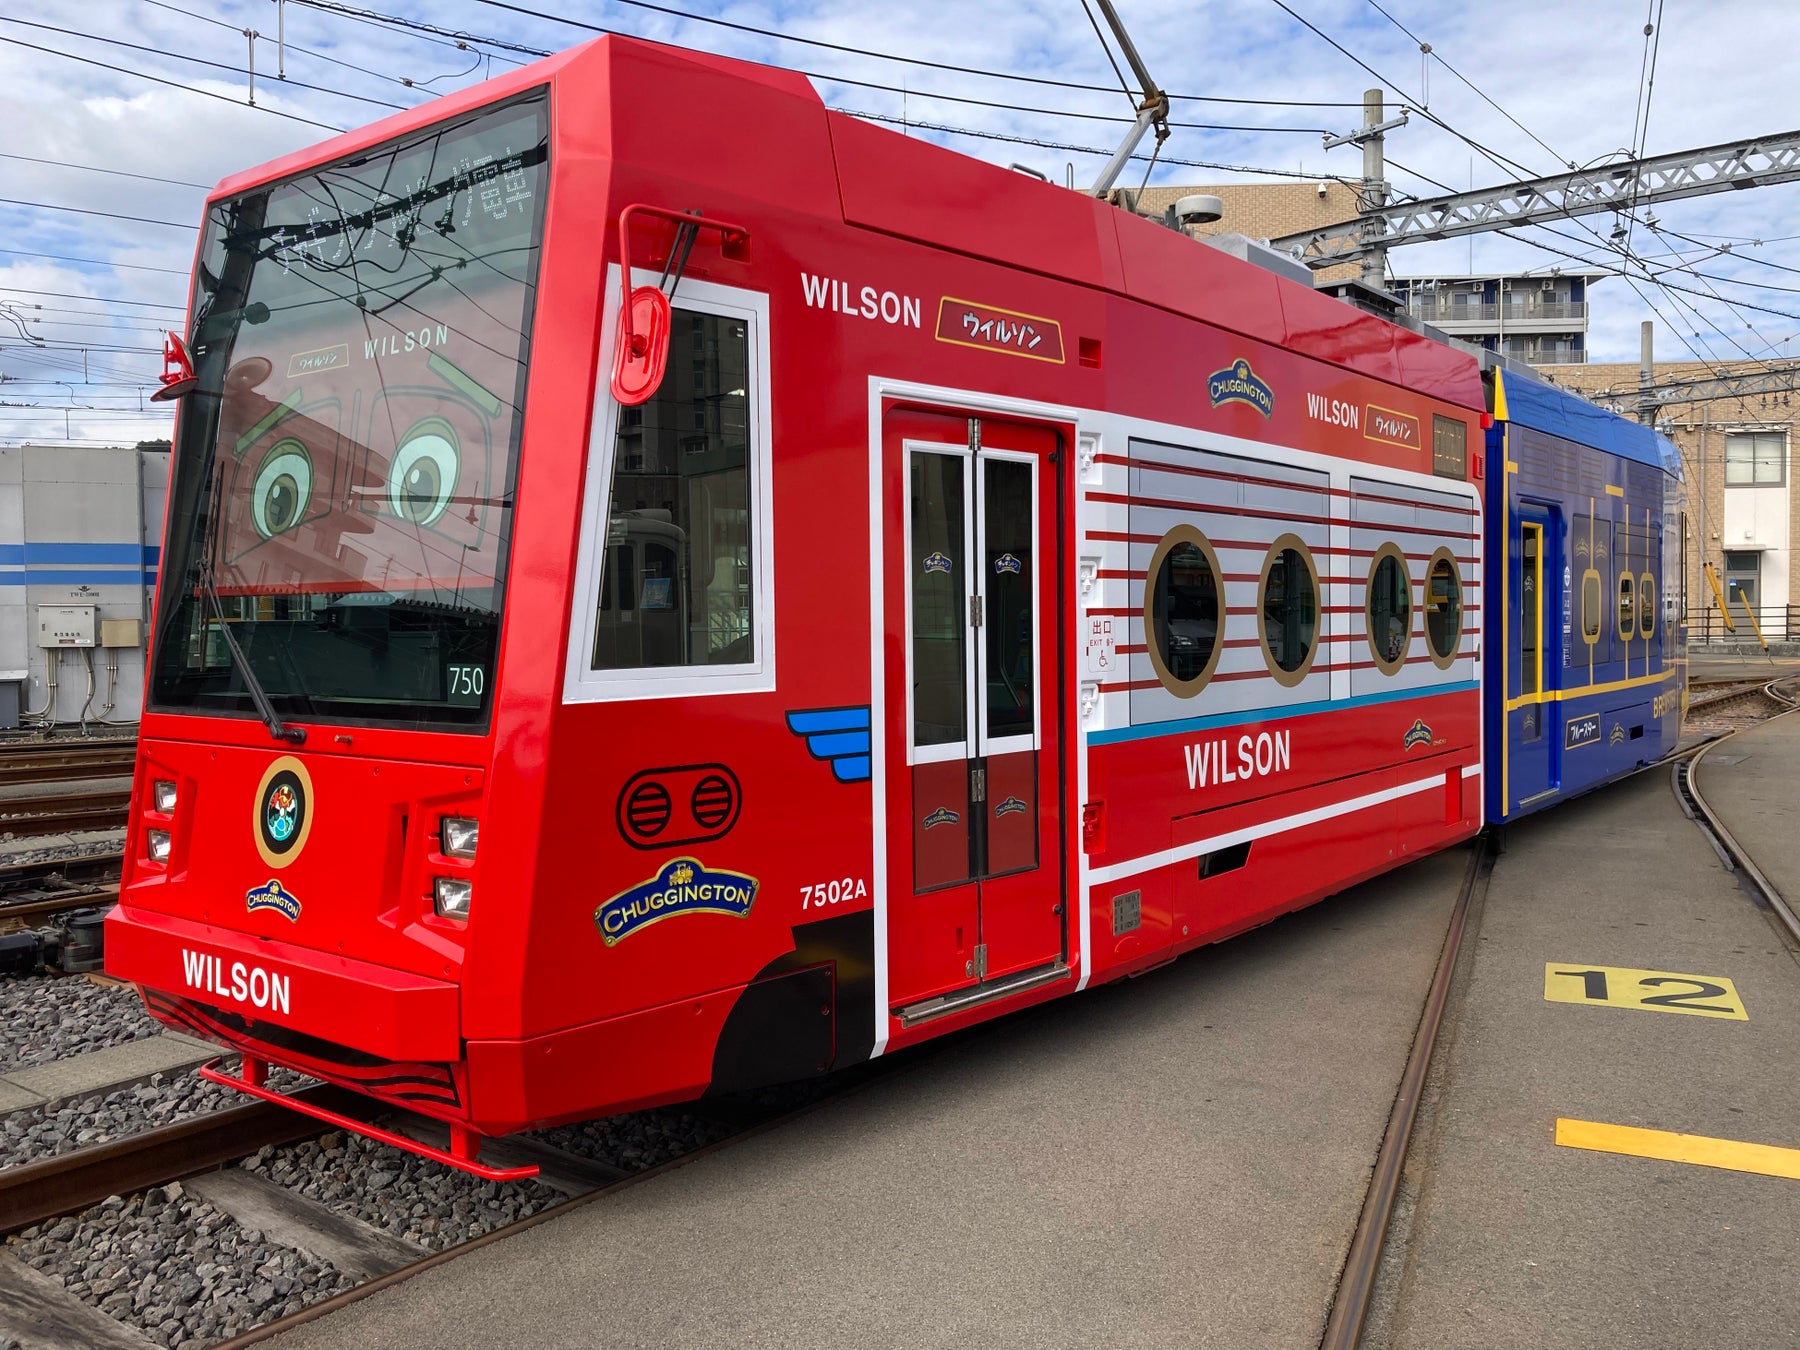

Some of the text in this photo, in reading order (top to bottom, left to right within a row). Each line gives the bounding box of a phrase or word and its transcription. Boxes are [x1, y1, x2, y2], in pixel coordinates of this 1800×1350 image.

[800, 272, 921, 329] WILSON
[364, 323, 449, 360] WILSON
[963, 312, 1042, 349] ウィルソン
[1210, 379, 1272, 411] CHUGGINGTON
[1307, 392, 1359, 430] WILSON
[1375, 415, 1411, 440] ウィルソン
[1089, 639, 1103, 647] EXIT
[1092, 619, 1111, 635] 出口
[449, 667, 484, 695] 750
[1184, 729, 1290, 790] WILSON
[247, 893, 299, 917] CHUGGINGTON
[603, 884, 751, 934] CHUGGINGTON
[799, 877, 868, 911] 7502A
[181, 948, 291, 1015] WILSON
